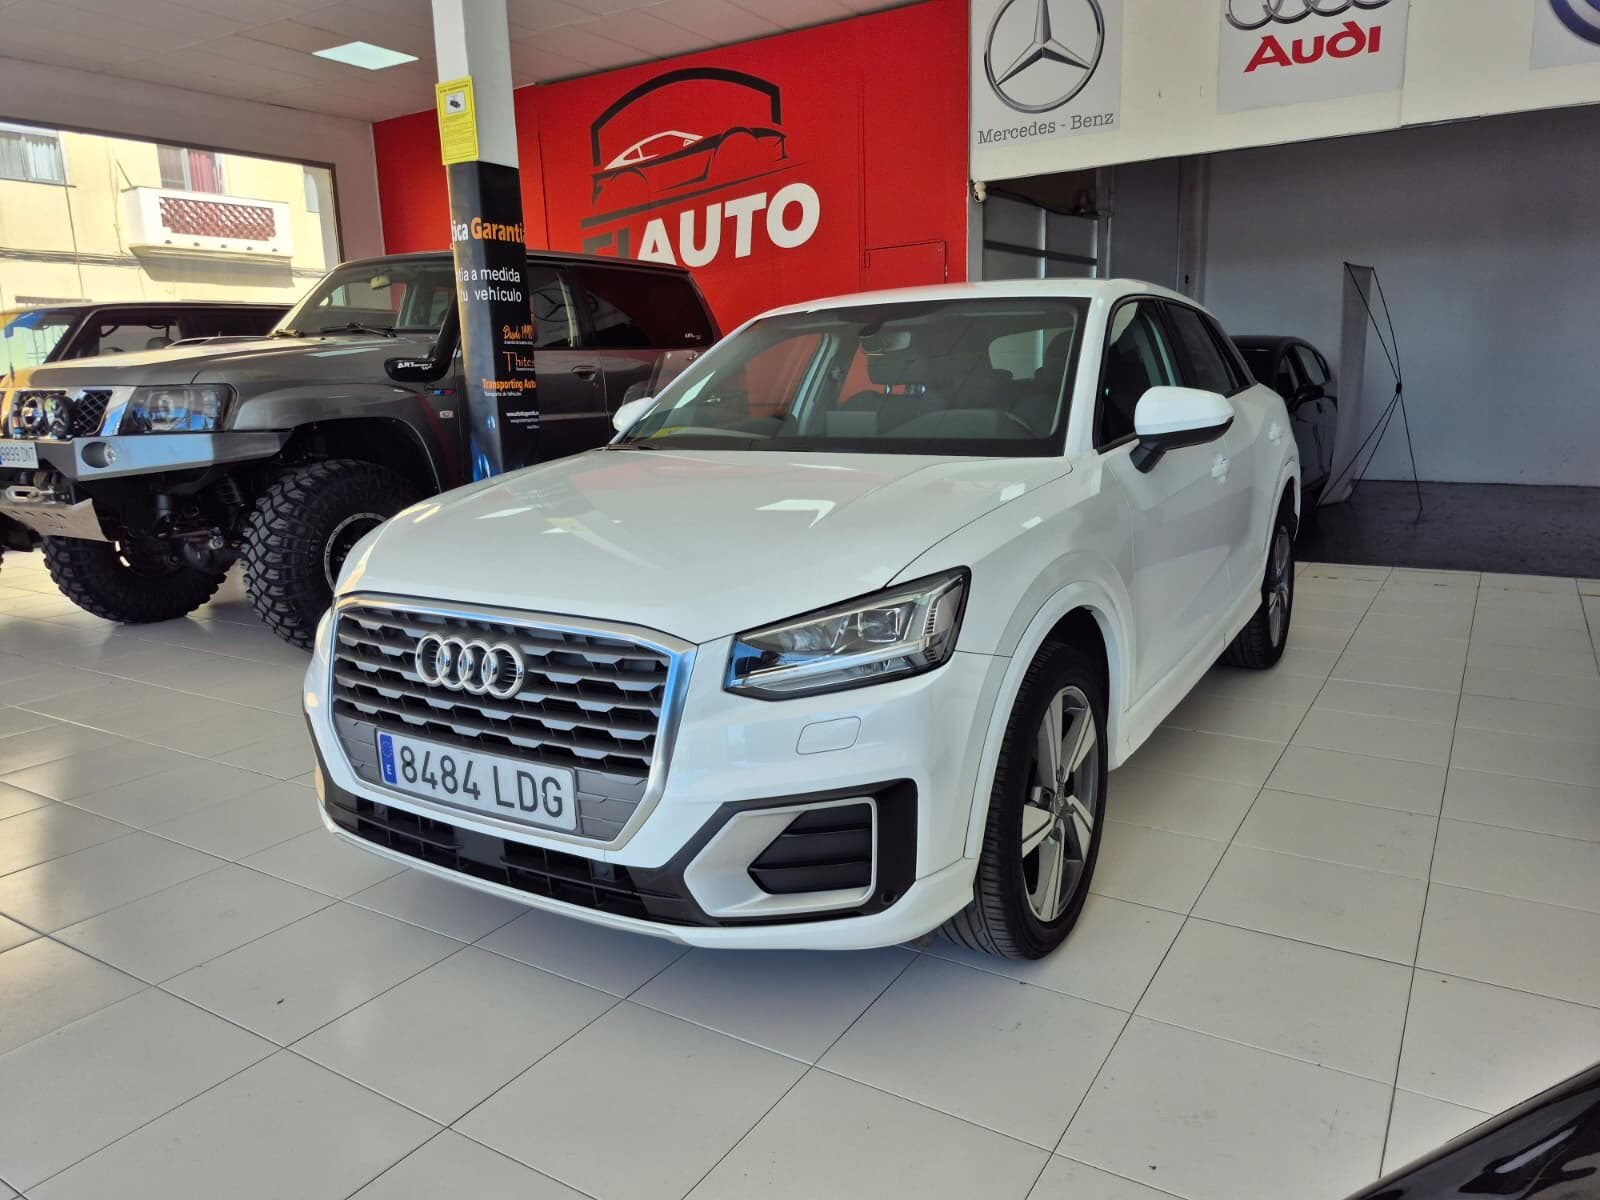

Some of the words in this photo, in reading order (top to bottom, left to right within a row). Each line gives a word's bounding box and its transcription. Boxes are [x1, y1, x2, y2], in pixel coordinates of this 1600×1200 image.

[1244, 20, 1381, 73] Audi
[977, 121, 1056, 145] Mercedes
[1070, 112, 1114, 130] Benz
[637, 182, 821, 268] AUTO
[471, 269, 477, 280] a
[480, 266, 521, 282] medida
[475, 285, 522, 302] vehículo
[386, 765, 393, 776] E
[400, 746, 480, 800] 8484
[492, 765, 563, 817] LDG
